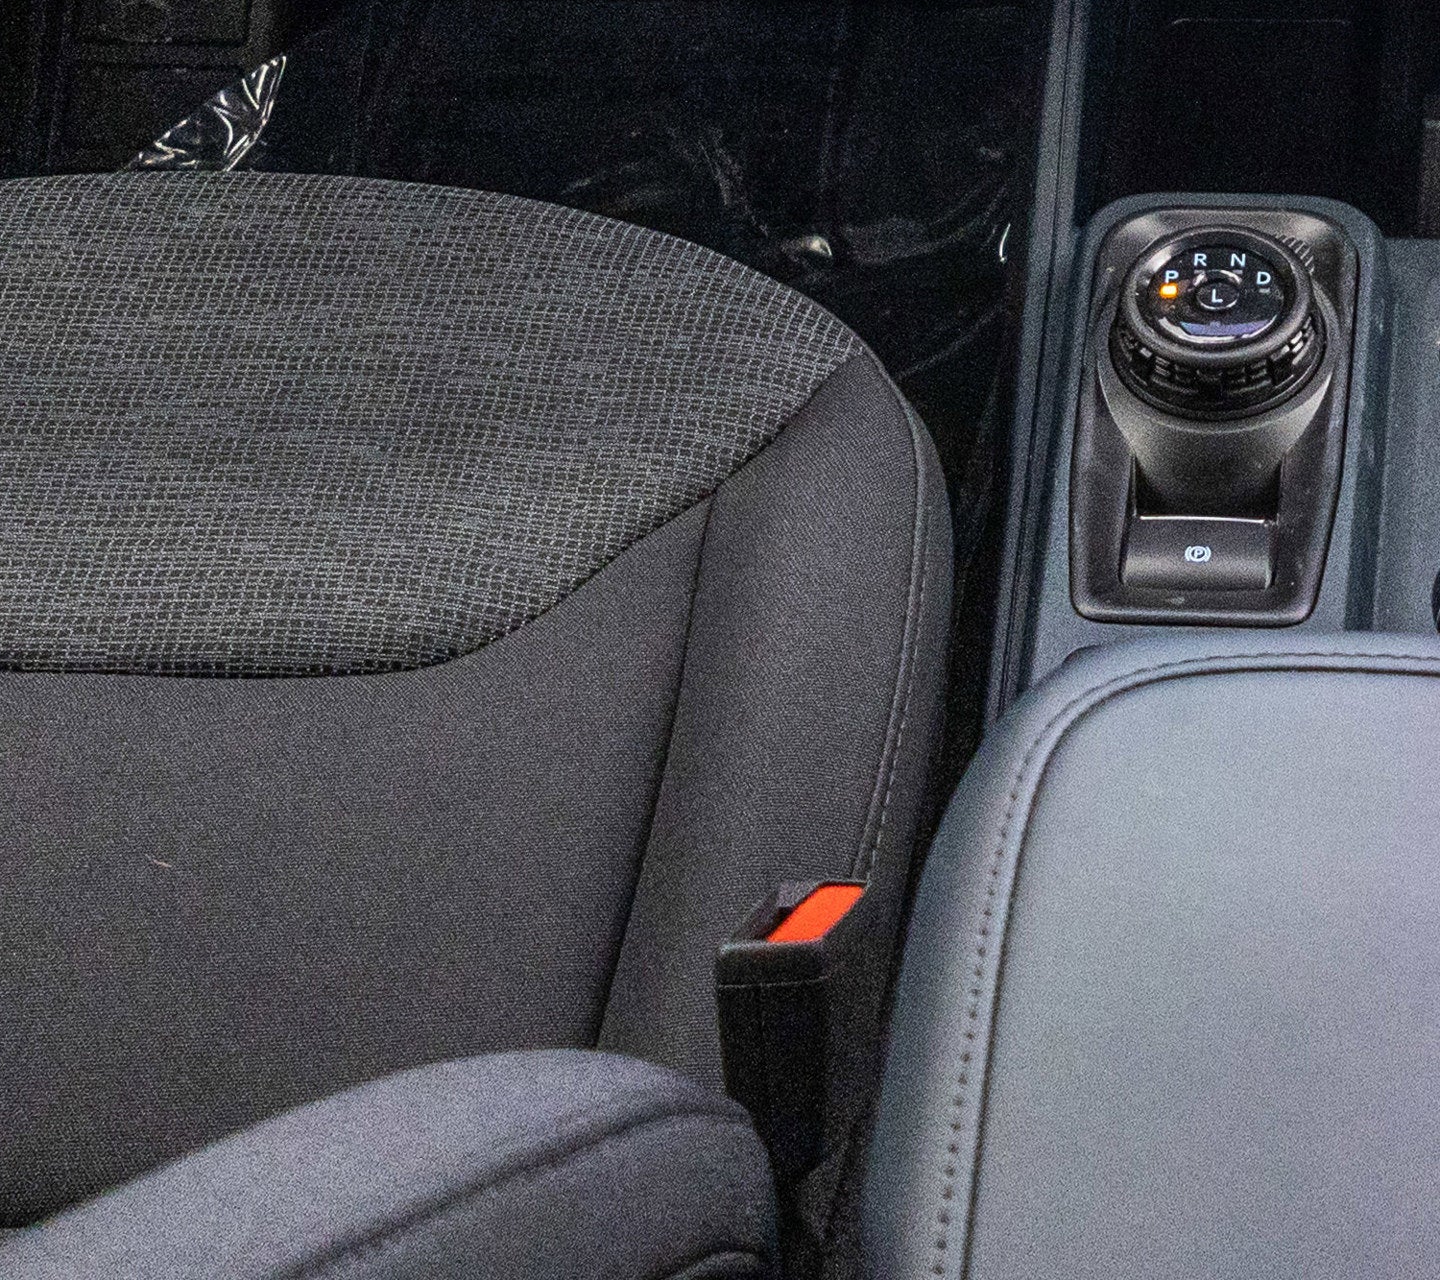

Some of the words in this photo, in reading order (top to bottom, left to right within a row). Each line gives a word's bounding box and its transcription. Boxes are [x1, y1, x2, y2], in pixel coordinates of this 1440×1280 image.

[1194, 253, 1208, 267] R
[1230, 253, 1246, 268] N
[1164, 270, 1179, 283] P
[1256, 271, 1271, 285] D
[1211, 288, 1223, 303] L
